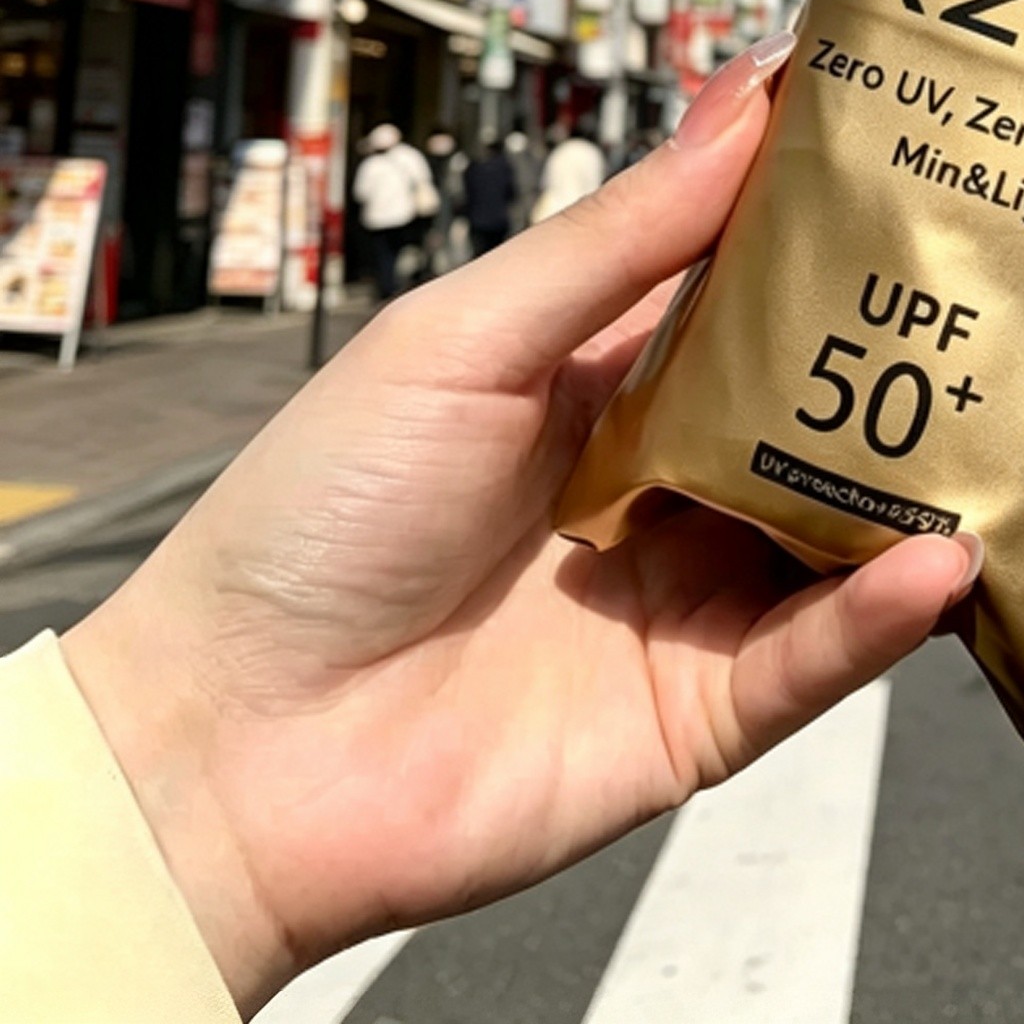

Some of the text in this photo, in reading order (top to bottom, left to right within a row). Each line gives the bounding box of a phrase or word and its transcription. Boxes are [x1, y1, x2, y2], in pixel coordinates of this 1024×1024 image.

[807, 37, 885, 91] Zero
[896, 70, 956, 126] UV,
[859, 272, 980, 352] UPF
